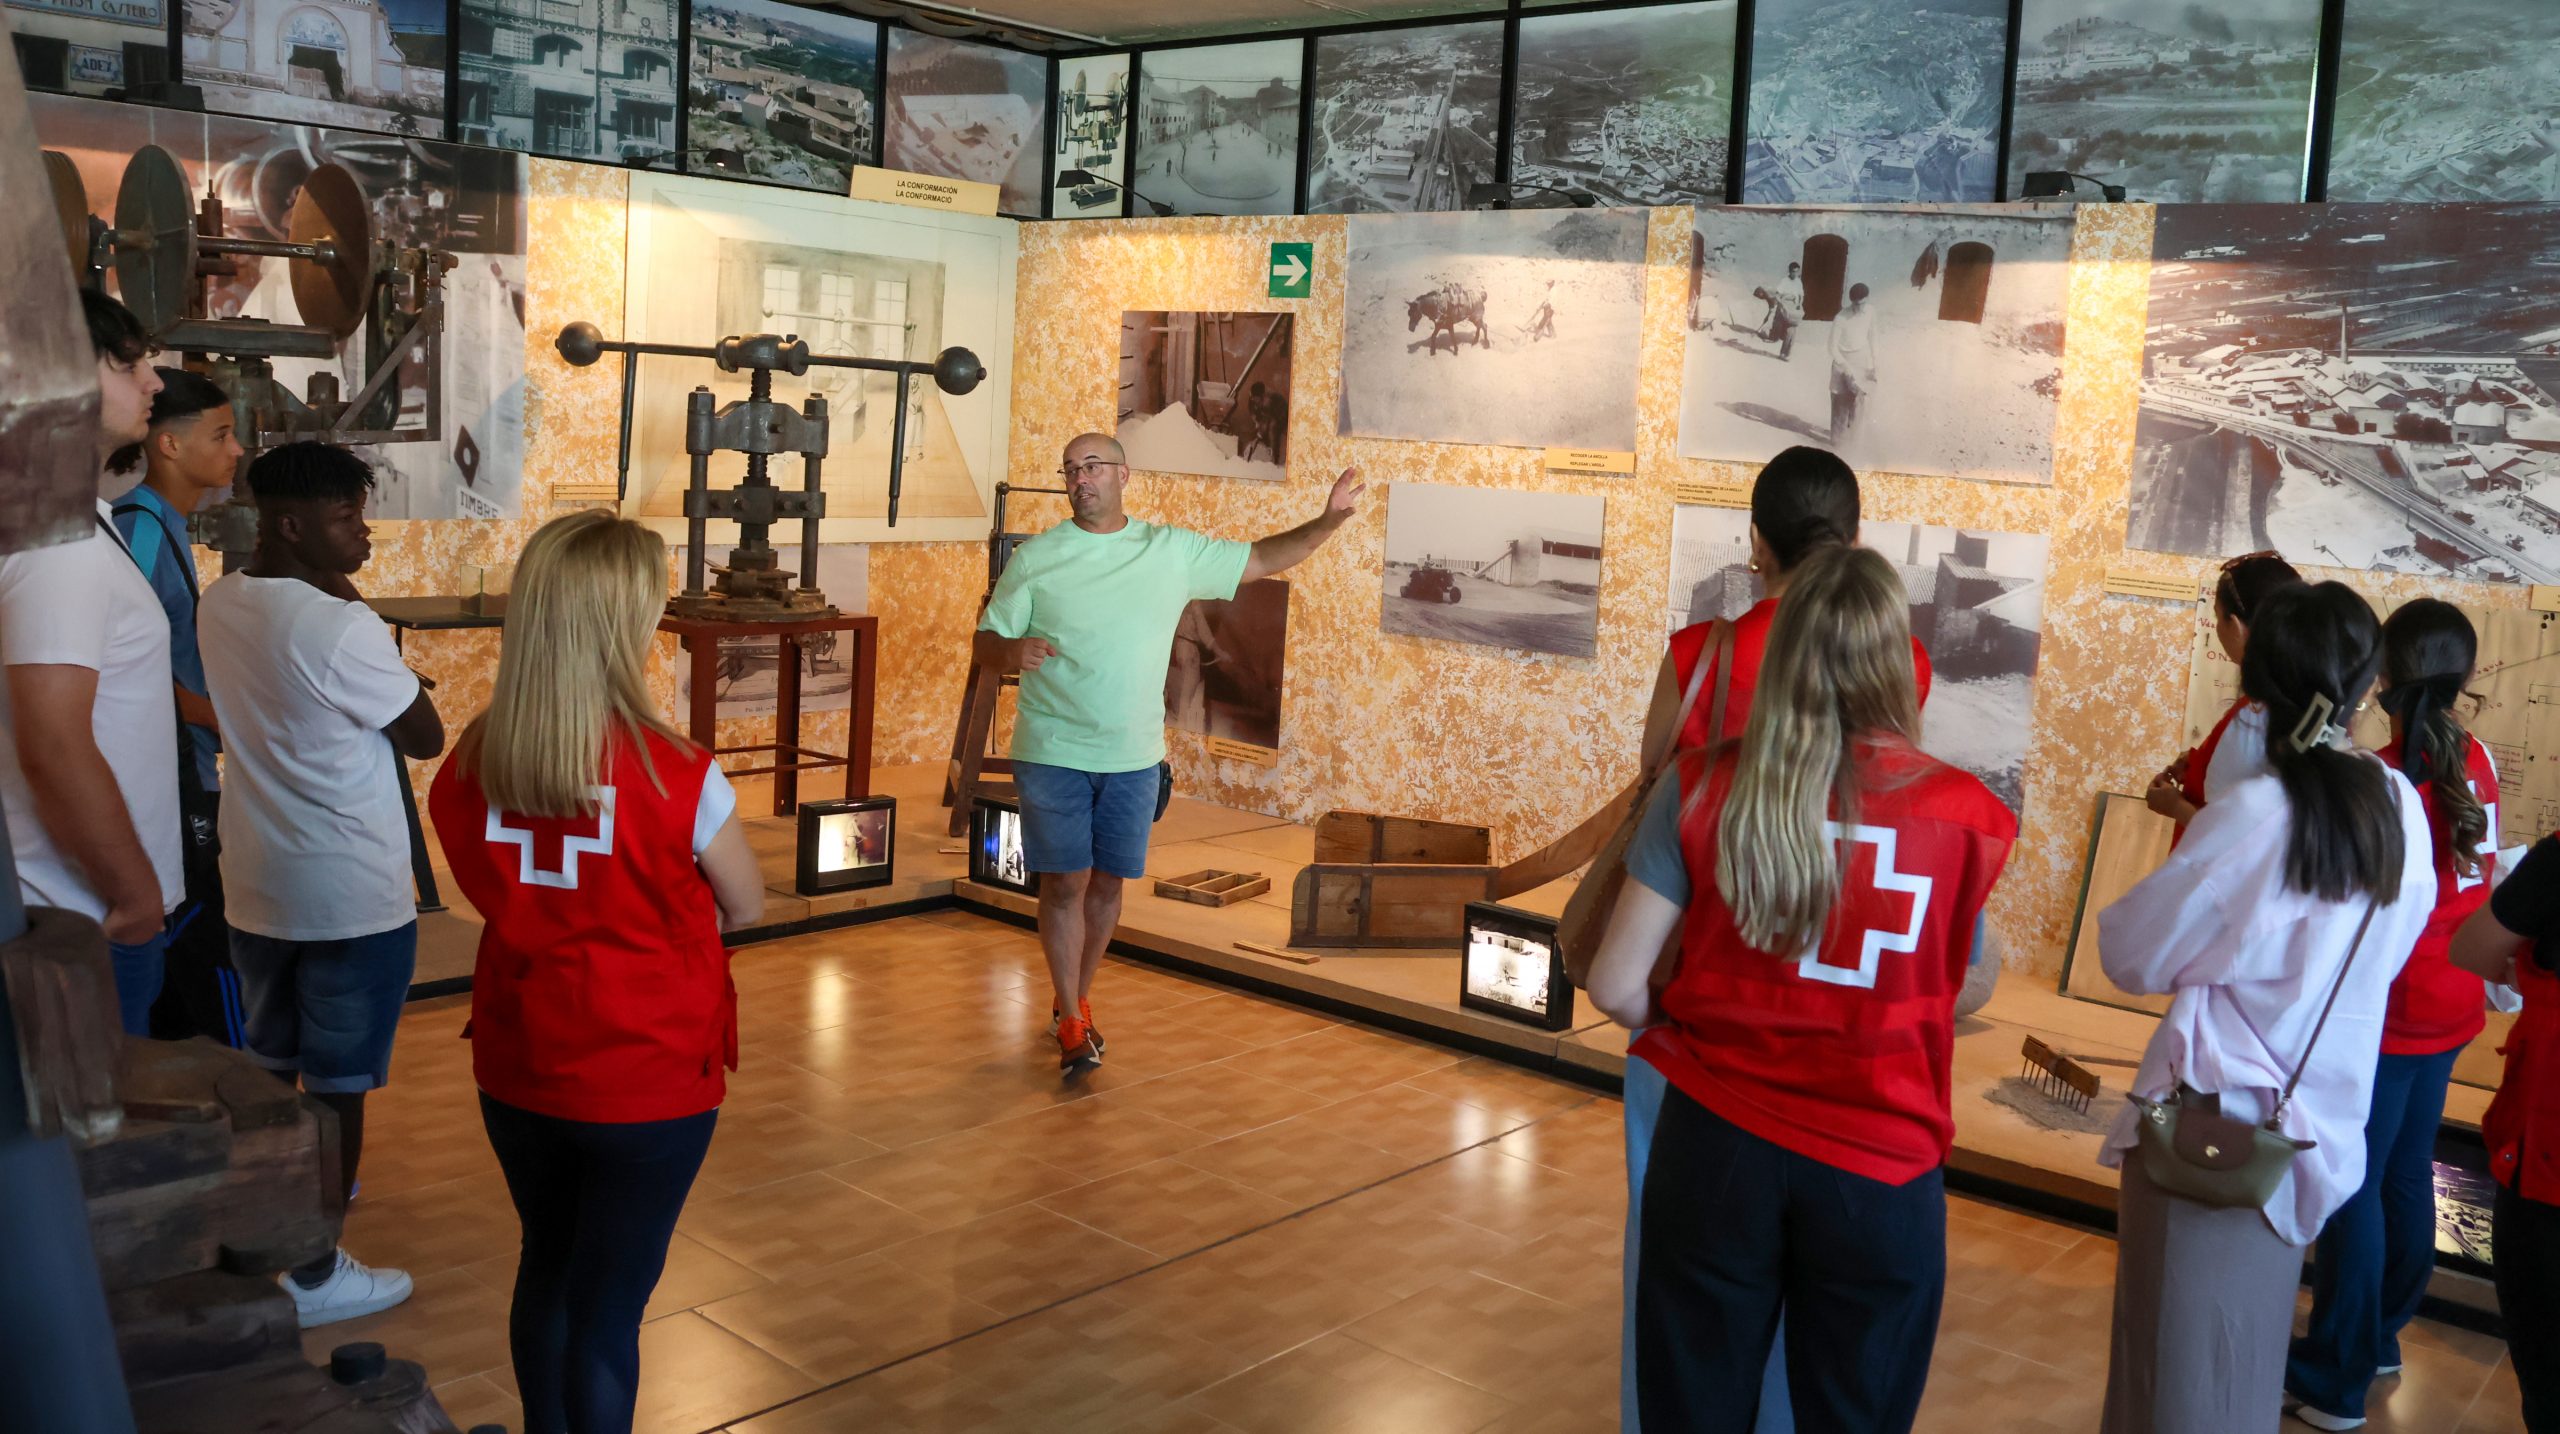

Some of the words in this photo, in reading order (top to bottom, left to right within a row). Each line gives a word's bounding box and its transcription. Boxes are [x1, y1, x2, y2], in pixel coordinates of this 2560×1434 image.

[897, 180, 906, 188] LA
[906, 181, 958, 194] CONFORMACIÓN
[905, 191, 953, 203] CONFORMACIÓ
[461, 490, 499, 519] TIMBRE
